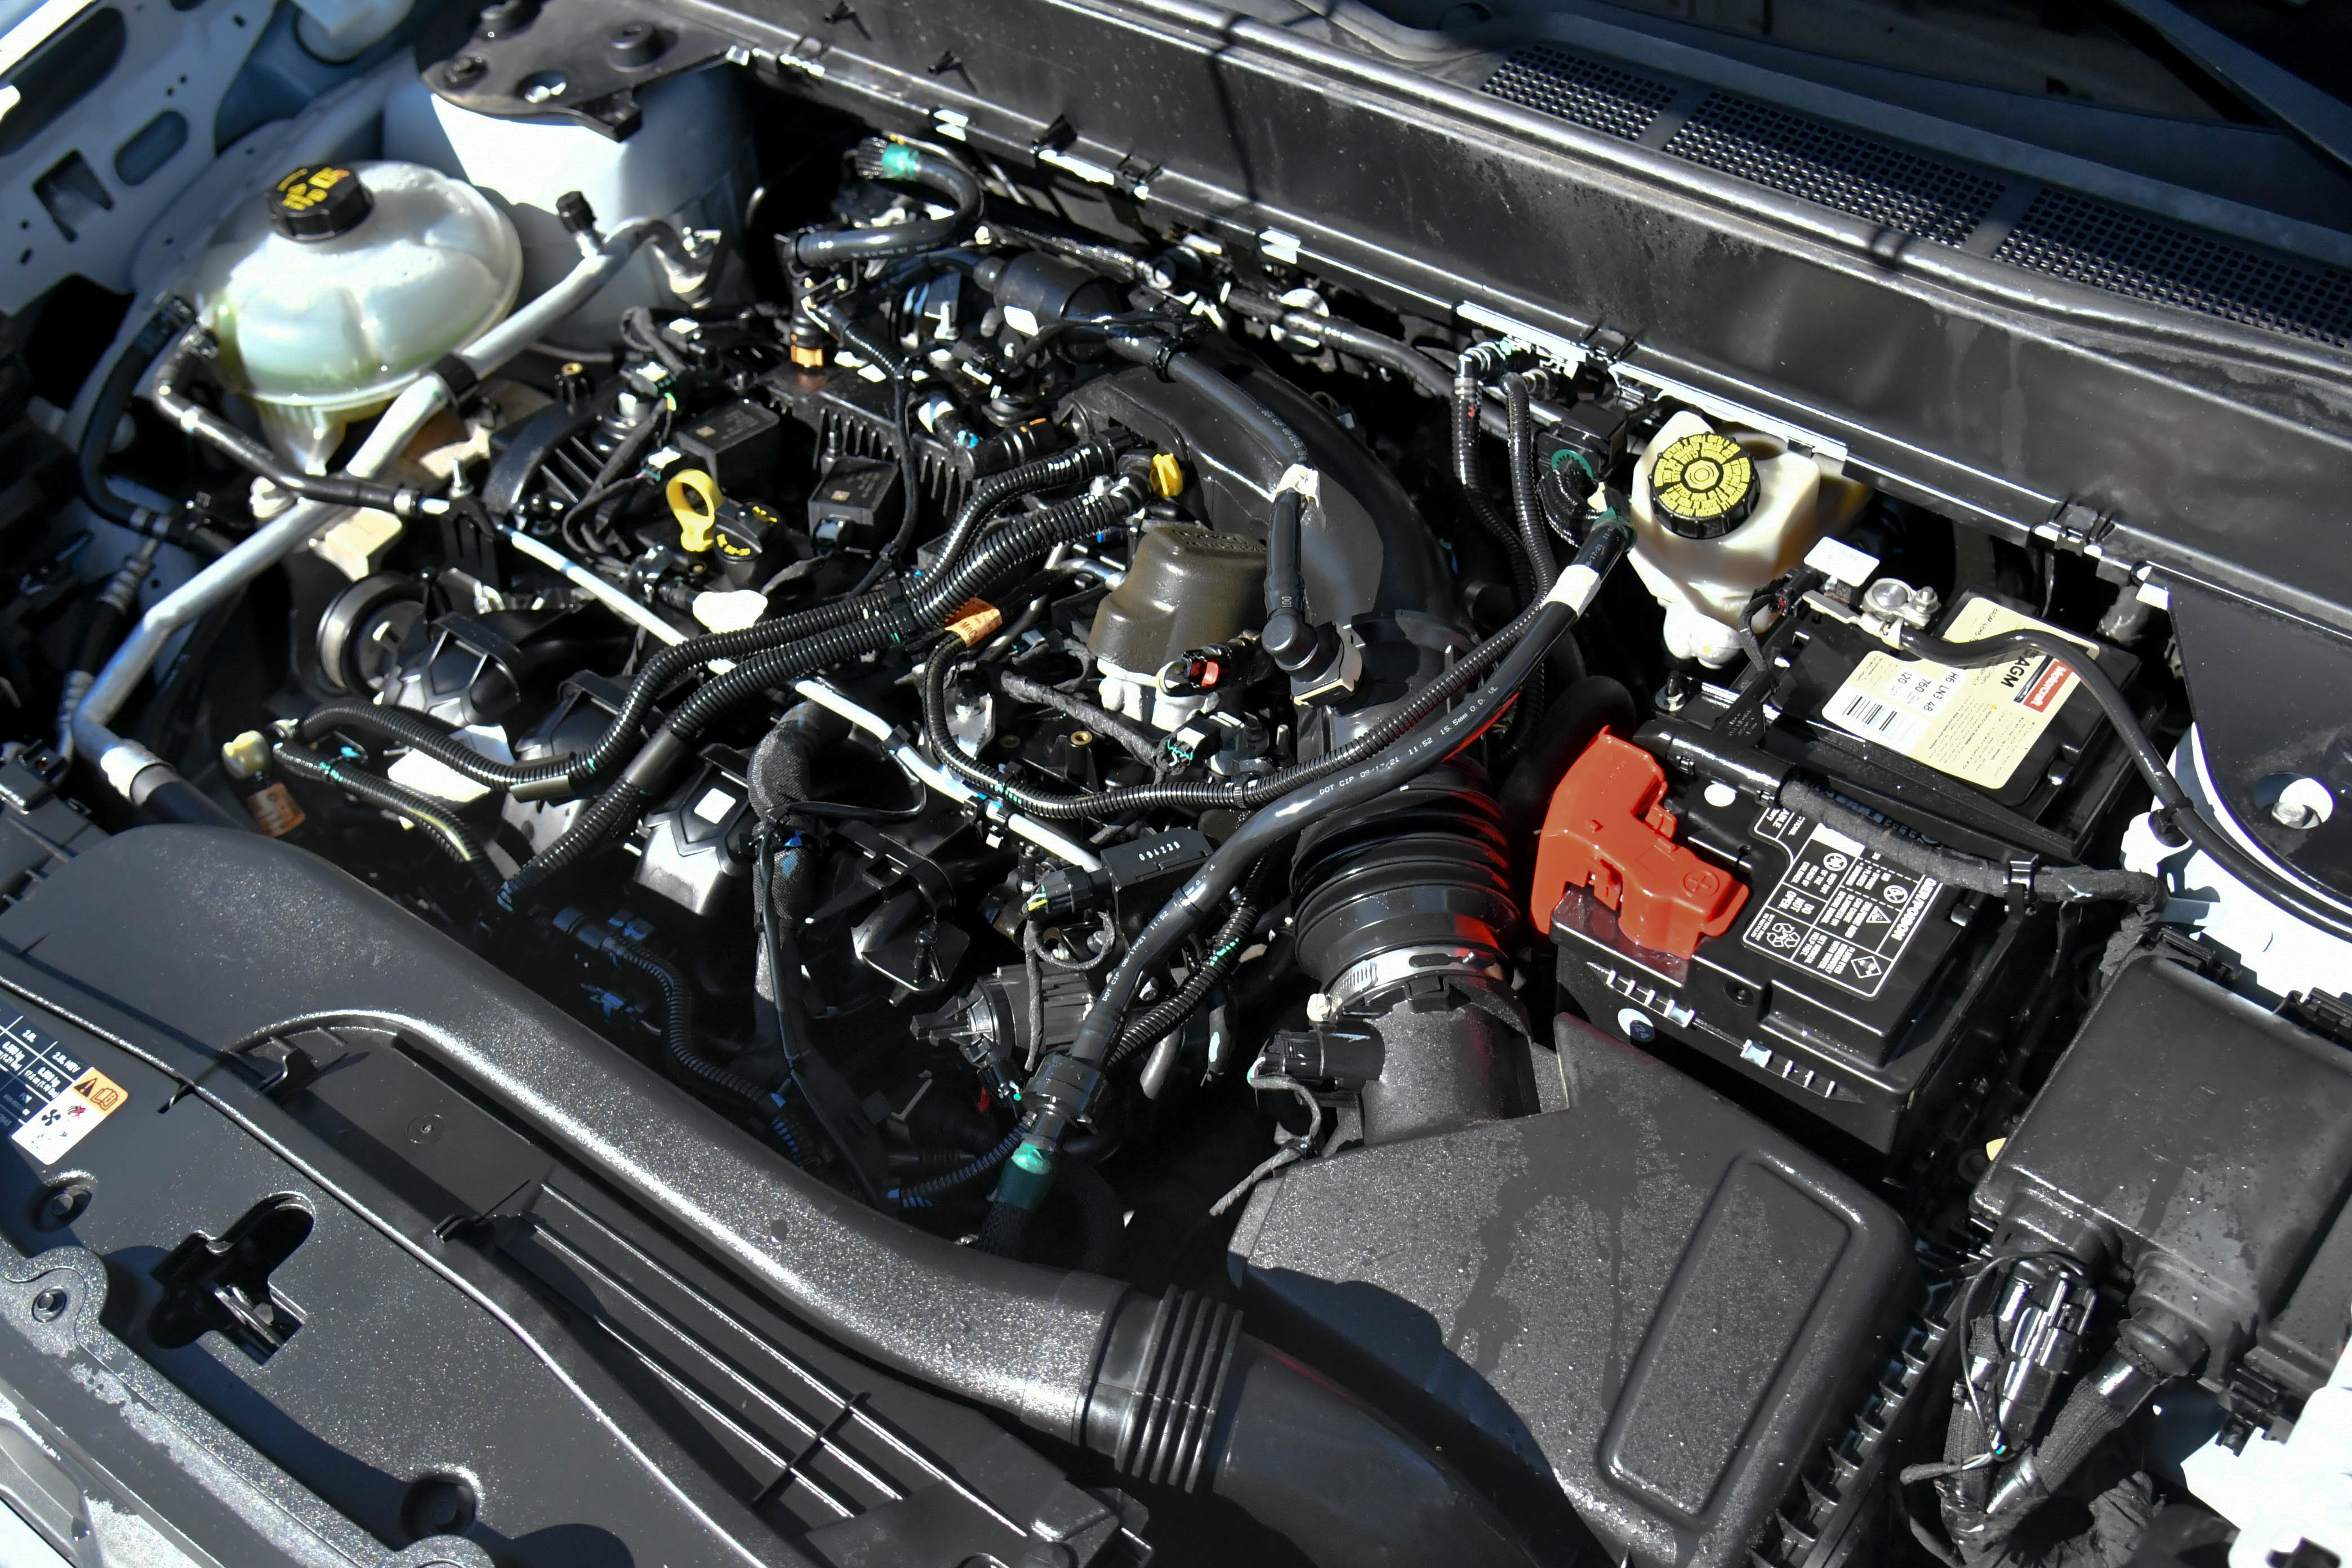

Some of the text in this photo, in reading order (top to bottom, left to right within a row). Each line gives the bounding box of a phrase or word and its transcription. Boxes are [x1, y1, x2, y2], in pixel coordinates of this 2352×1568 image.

[1897, 672, 1913, 685] 120
[2000, 656, 2031, 688] AGM
[1914, 678, 1931, 693] 760
[1923, 671, 1959, 712] H6 LN3 48
[2031, 666, 2066, 705] Motorcraft
[1319, 784, 1334, 795] DOT
[1339, 776, 1354, 787] CIP
[1773, 809, 1789, 828] ABLE
[1805, 865, 1819, 881] REACH
[1814, 870, 1828, 885] OF THE
[1820, 873, 1837, 894] KEEP OUT
[1778, 891, 1797, 909] OPEN.
[1790, 898, 1806, 912] NOT
[1801, 903, 1815, 914] DO
[1831, 891, 1846, 909] SEVERE
[1843, 907, 1857, 923] CAUSE
[1751, 919, 1766, 937] RECYCLED
[1755, 914, 1775, 941] BATTERY MUST
[1808, 932, 1820, 945] HELP
[1817, 935, 1827, 945] GET
[1828, 941, 1841, 955] WITH
[1834, 947, 1855, 974] FLUSH EYES
[1102, 988, 1111, 1002] DOT
[1111, 971, 1120, 985] CIP
